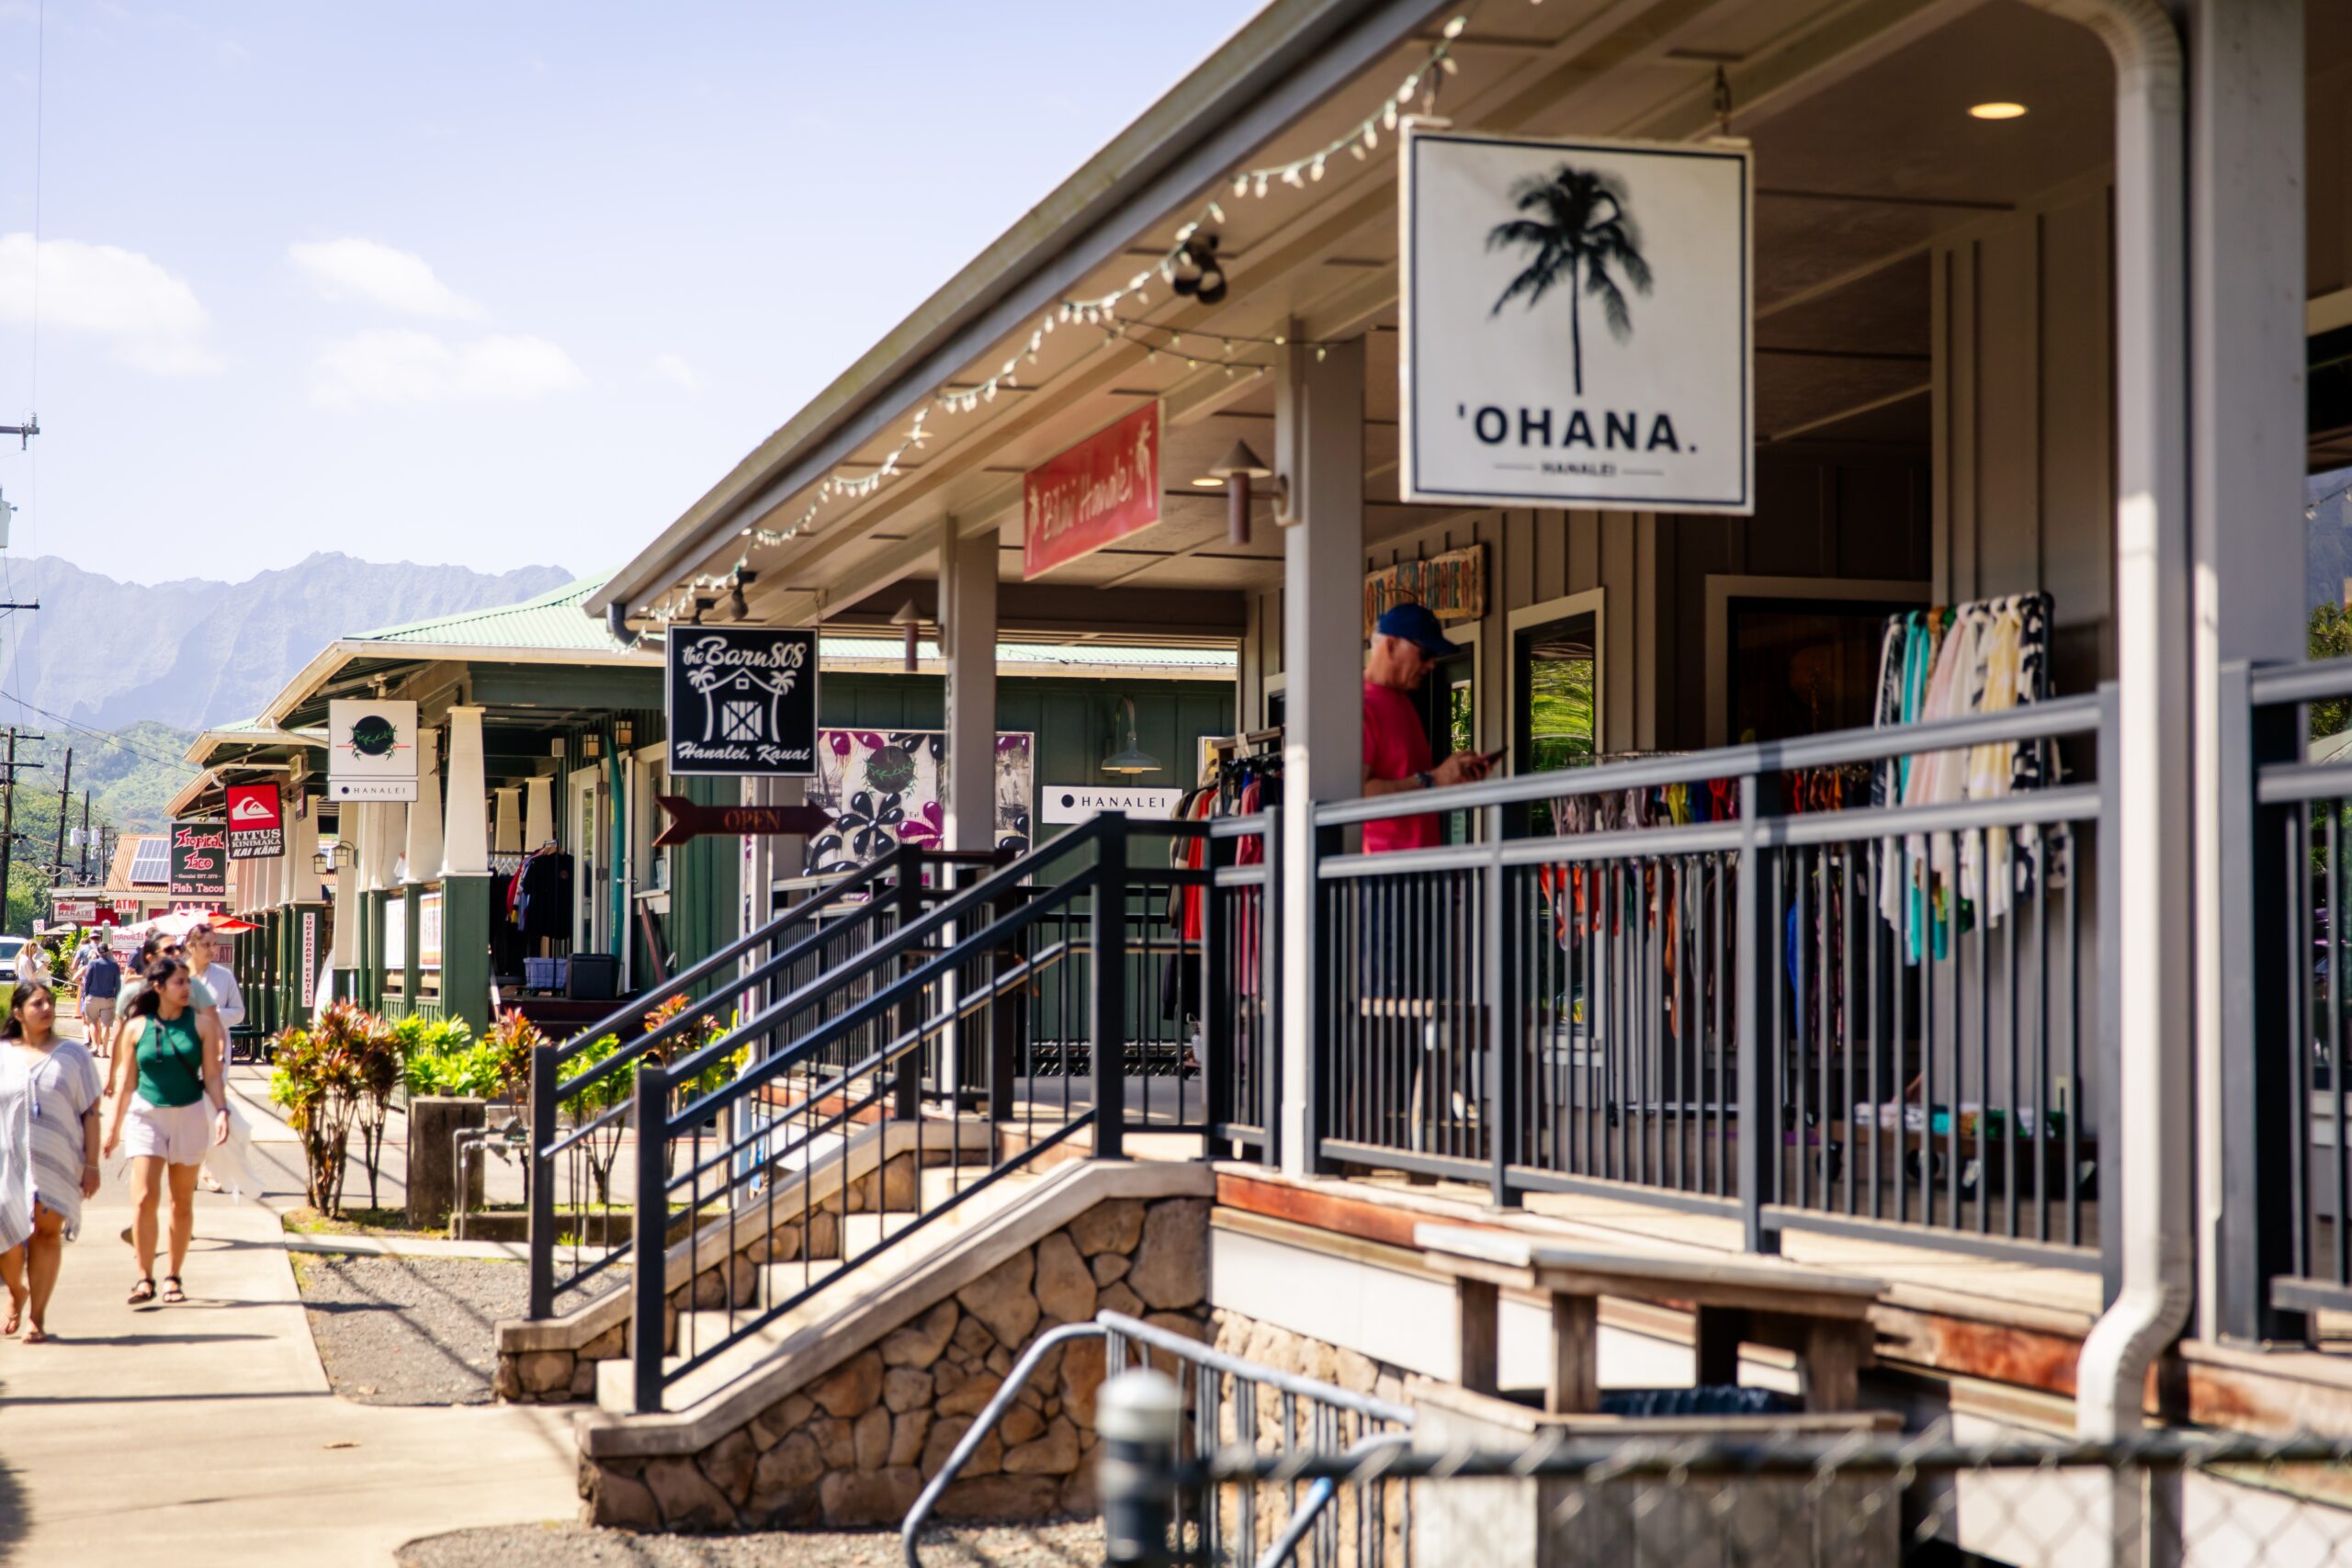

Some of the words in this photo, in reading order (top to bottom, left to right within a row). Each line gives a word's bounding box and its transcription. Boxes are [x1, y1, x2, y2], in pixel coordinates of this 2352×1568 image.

[757, 743, 809, 766] Kauai
[1081, 795, 1166, 808] HANALEI
[723, 808, 781, 830] OPEN
[231, 829, 281, 840] TITUS
[232, 838, 281, 848] KINIMAKA
[233, 847, 253, 858] KAI
[172, 883, 193, 893] Fish
[196, 883, 224, 893] Tacos
[115, 899, 138, 909] ATM
